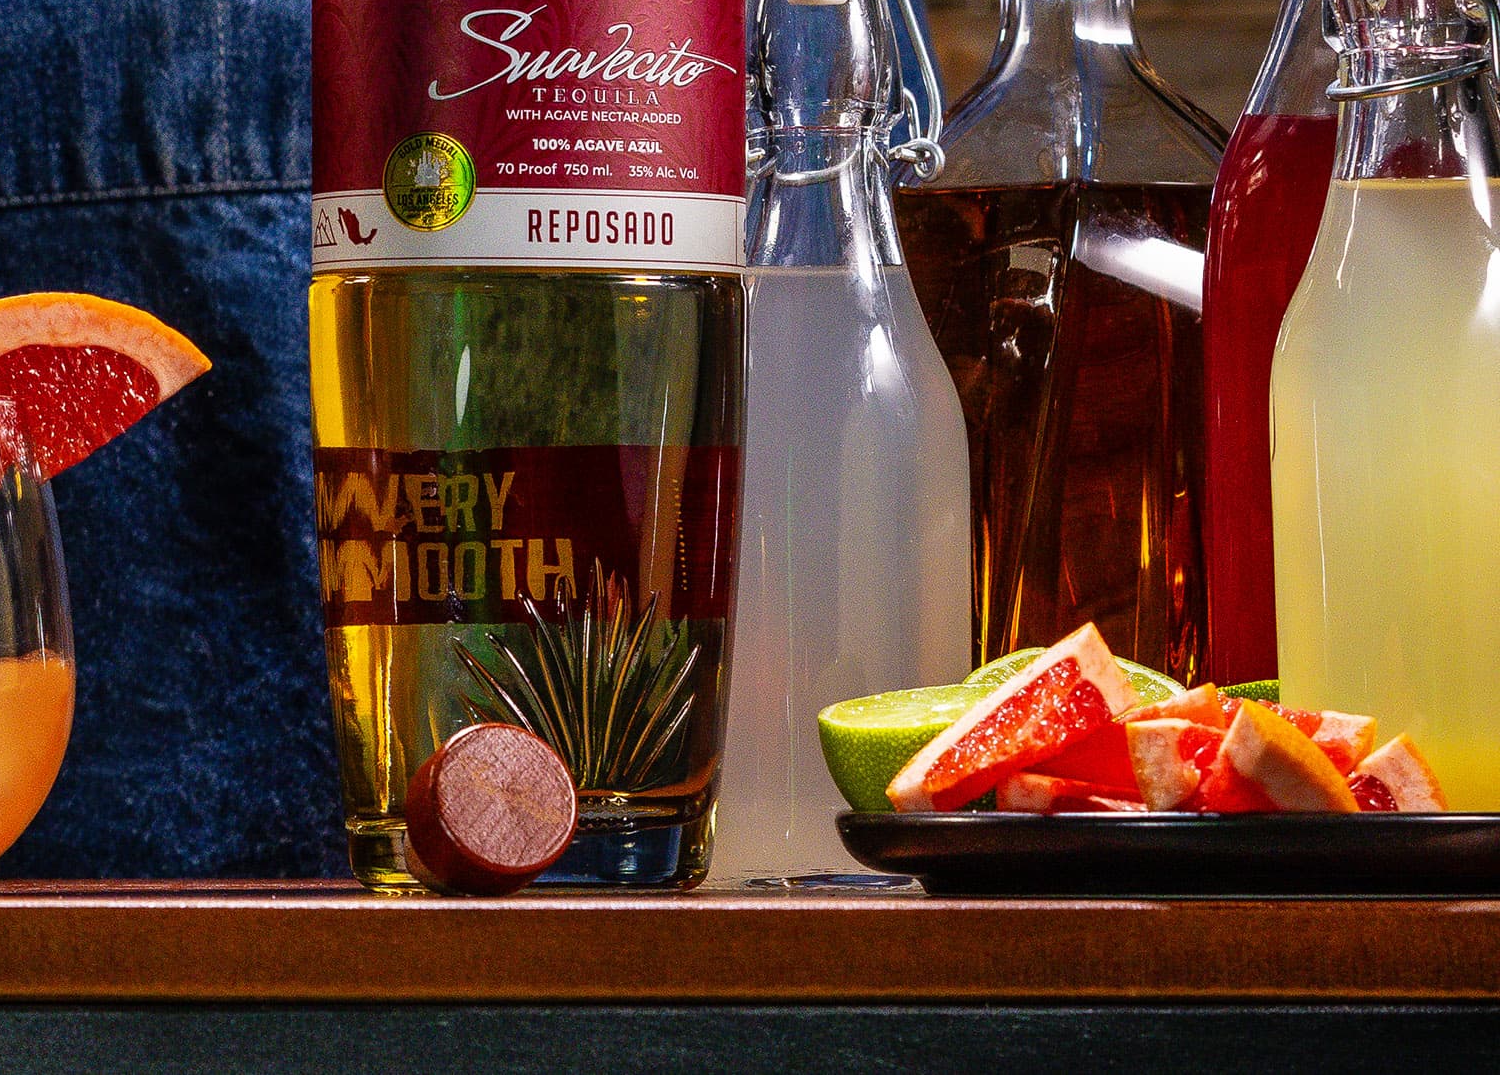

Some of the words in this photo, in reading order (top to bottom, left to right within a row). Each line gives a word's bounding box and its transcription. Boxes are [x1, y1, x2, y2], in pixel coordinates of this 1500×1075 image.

[428, 4, 737, 101] Suavecito
[532, 87, 660, 106] TEQUILA
[506, 109, 541, 121] WITH
[544, 109, 588, 122] AGAVE
[591, 110, 640, 124] NECTAR
[640, 112, 682, 125] ADDED
[398, 138, 423, 159] GOLD
[425, 136, 459, 160] MEDAL
[532, 138, 571, 151] 100%
[573, 138, 625, 153] AGAVE
[627, 139, 663, 154] AZUL
[496, 162, 515, 175] 70
[518, 162, 558, 175] Proof
[563, 163, 589, 176] 750
[592, 163, 613, 177] ml.
[628, 164, 654, 178] 35%
[655, 166, 678, 179] Alc.
[678, 167, 700, 180] Vol.
[396, 193, 414, 206] LOS
[416, 192, 459, 206] ANGELES
[528, 208, 674, 246] REPOSADO
